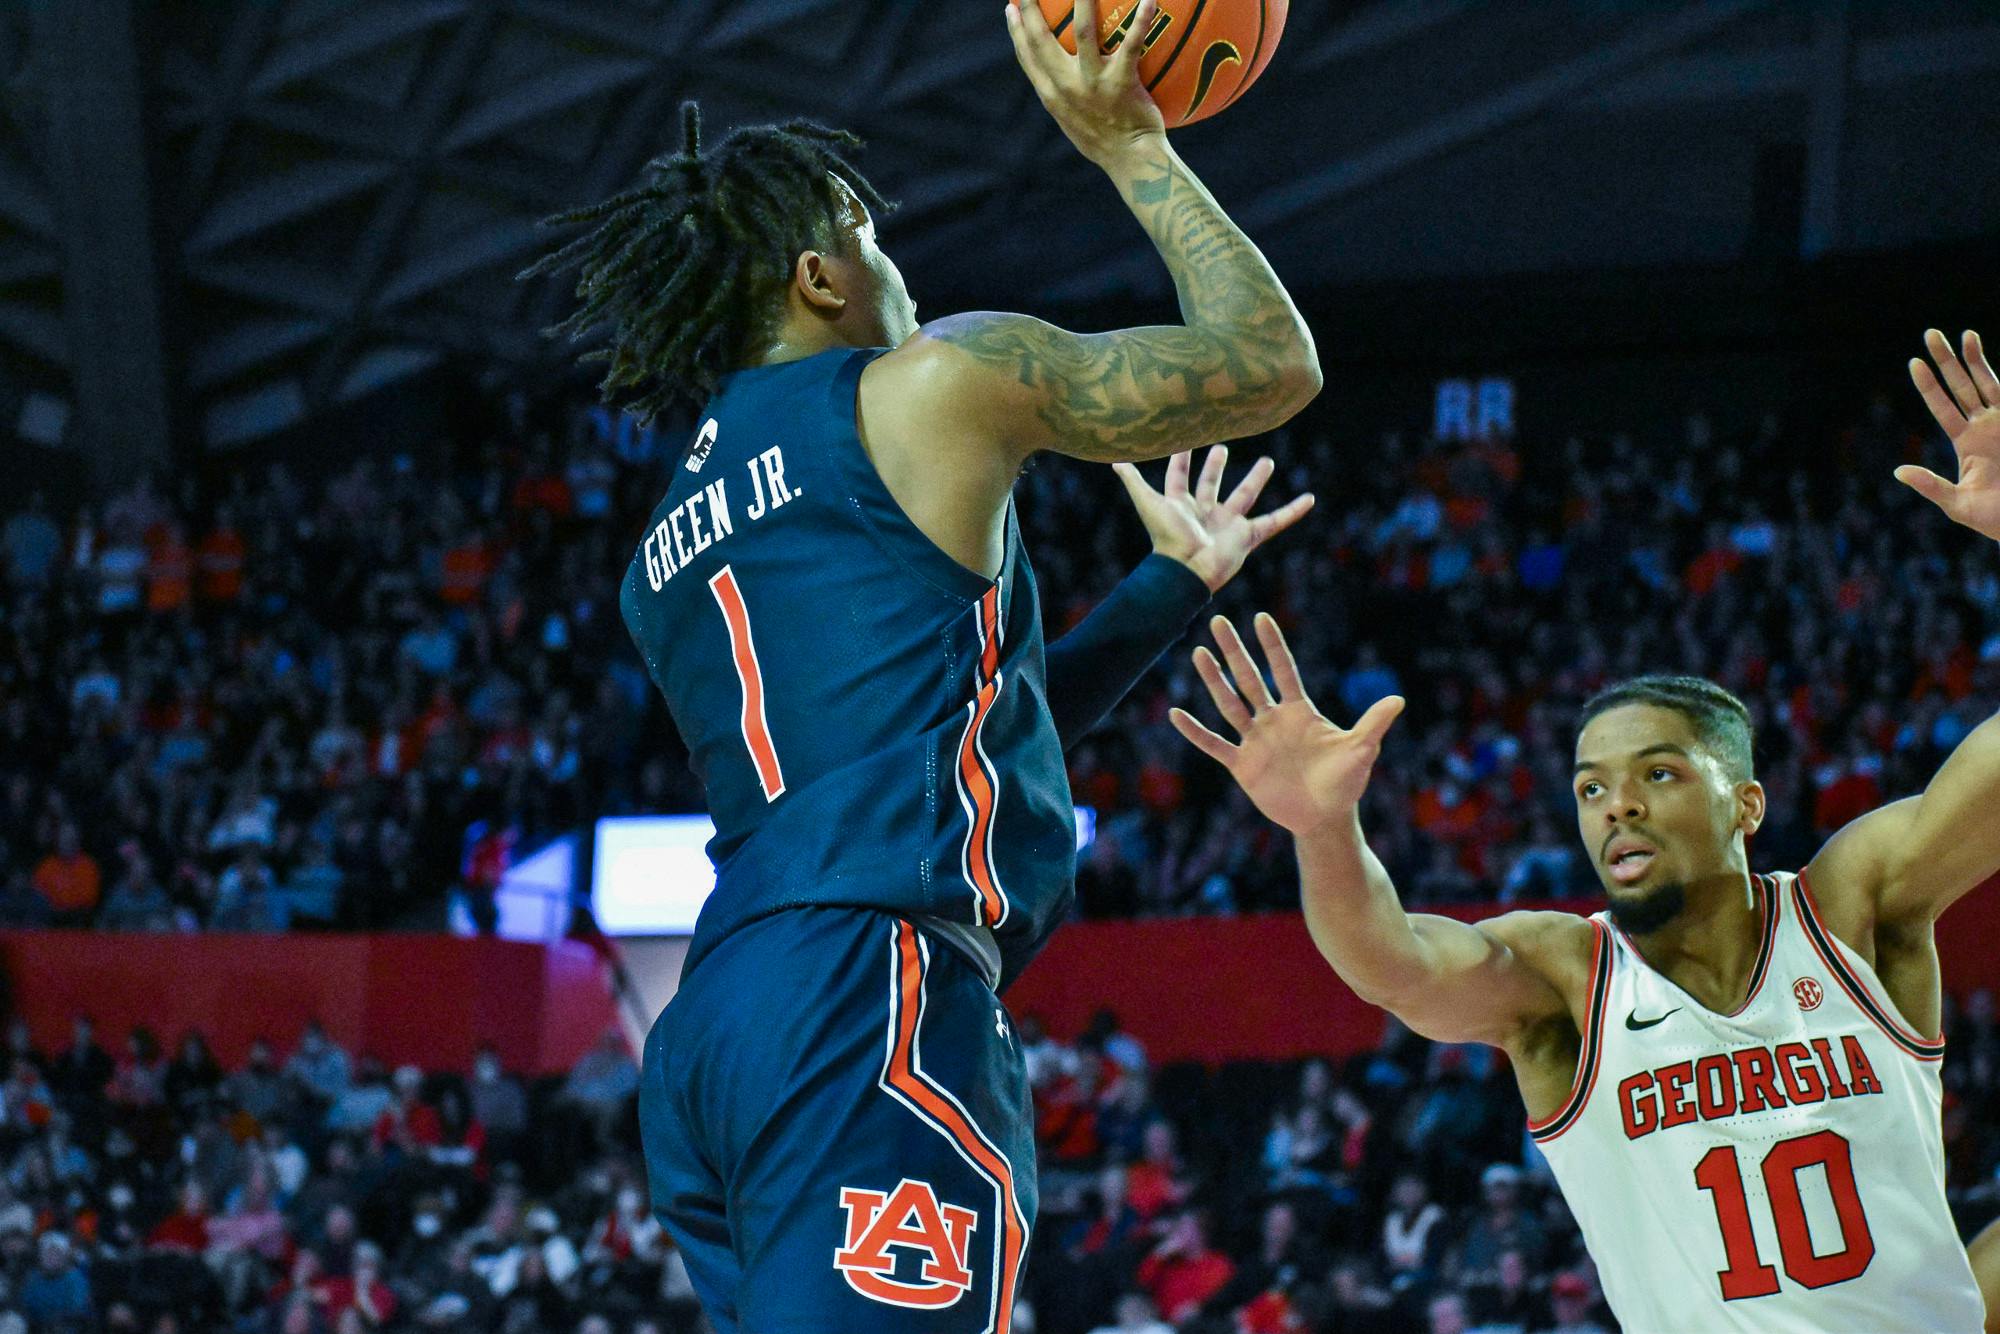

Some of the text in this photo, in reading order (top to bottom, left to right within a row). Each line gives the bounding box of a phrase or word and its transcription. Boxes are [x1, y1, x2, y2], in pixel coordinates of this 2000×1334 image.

[644, 445, 803, 592] GREEN JR.
[708, 564, 786, 804] 1
[1793, 980, 1821, 1008] SEC
[1617, 1035, 1884, 1140] GEORGIA
[1693, 1129, 1876, 1302] 10
